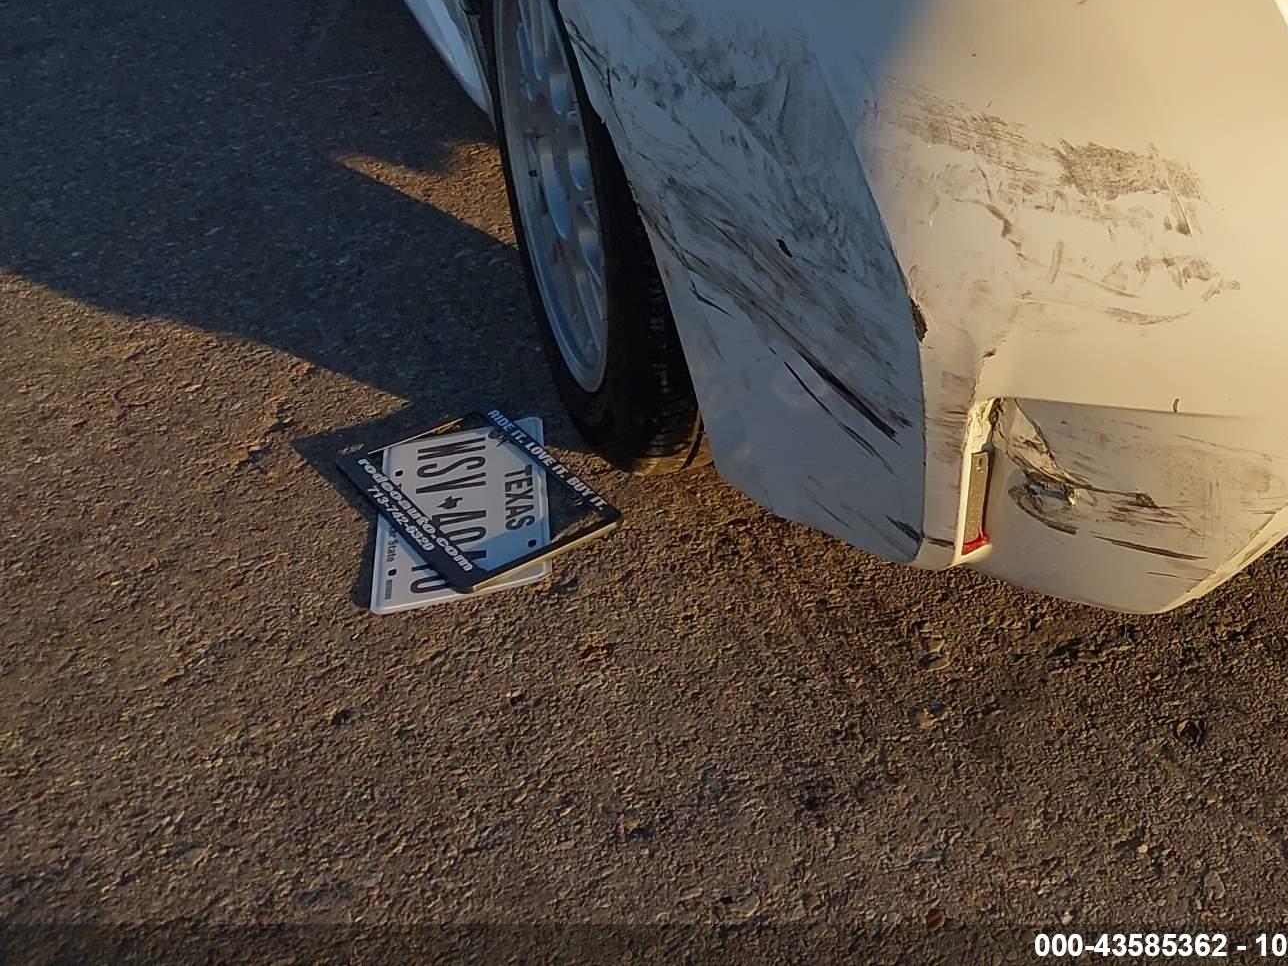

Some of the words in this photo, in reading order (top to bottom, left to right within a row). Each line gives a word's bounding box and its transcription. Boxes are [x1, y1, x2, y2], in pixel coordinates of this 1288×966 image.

[487, 409, 514, 432] RIDE
[511, 429, 527, 445] IT.
[525, 442, 557, 467] LOVE
[552, 464, 569, 479] IT.
[566, 475, 595, 497] BUY
[590, 493, 609, 511] IT.
[504, 464, 535, 531] TEXAS
[357, 457, 475, 573] rodeoauto.com
[386, 539, 399, 563] State
